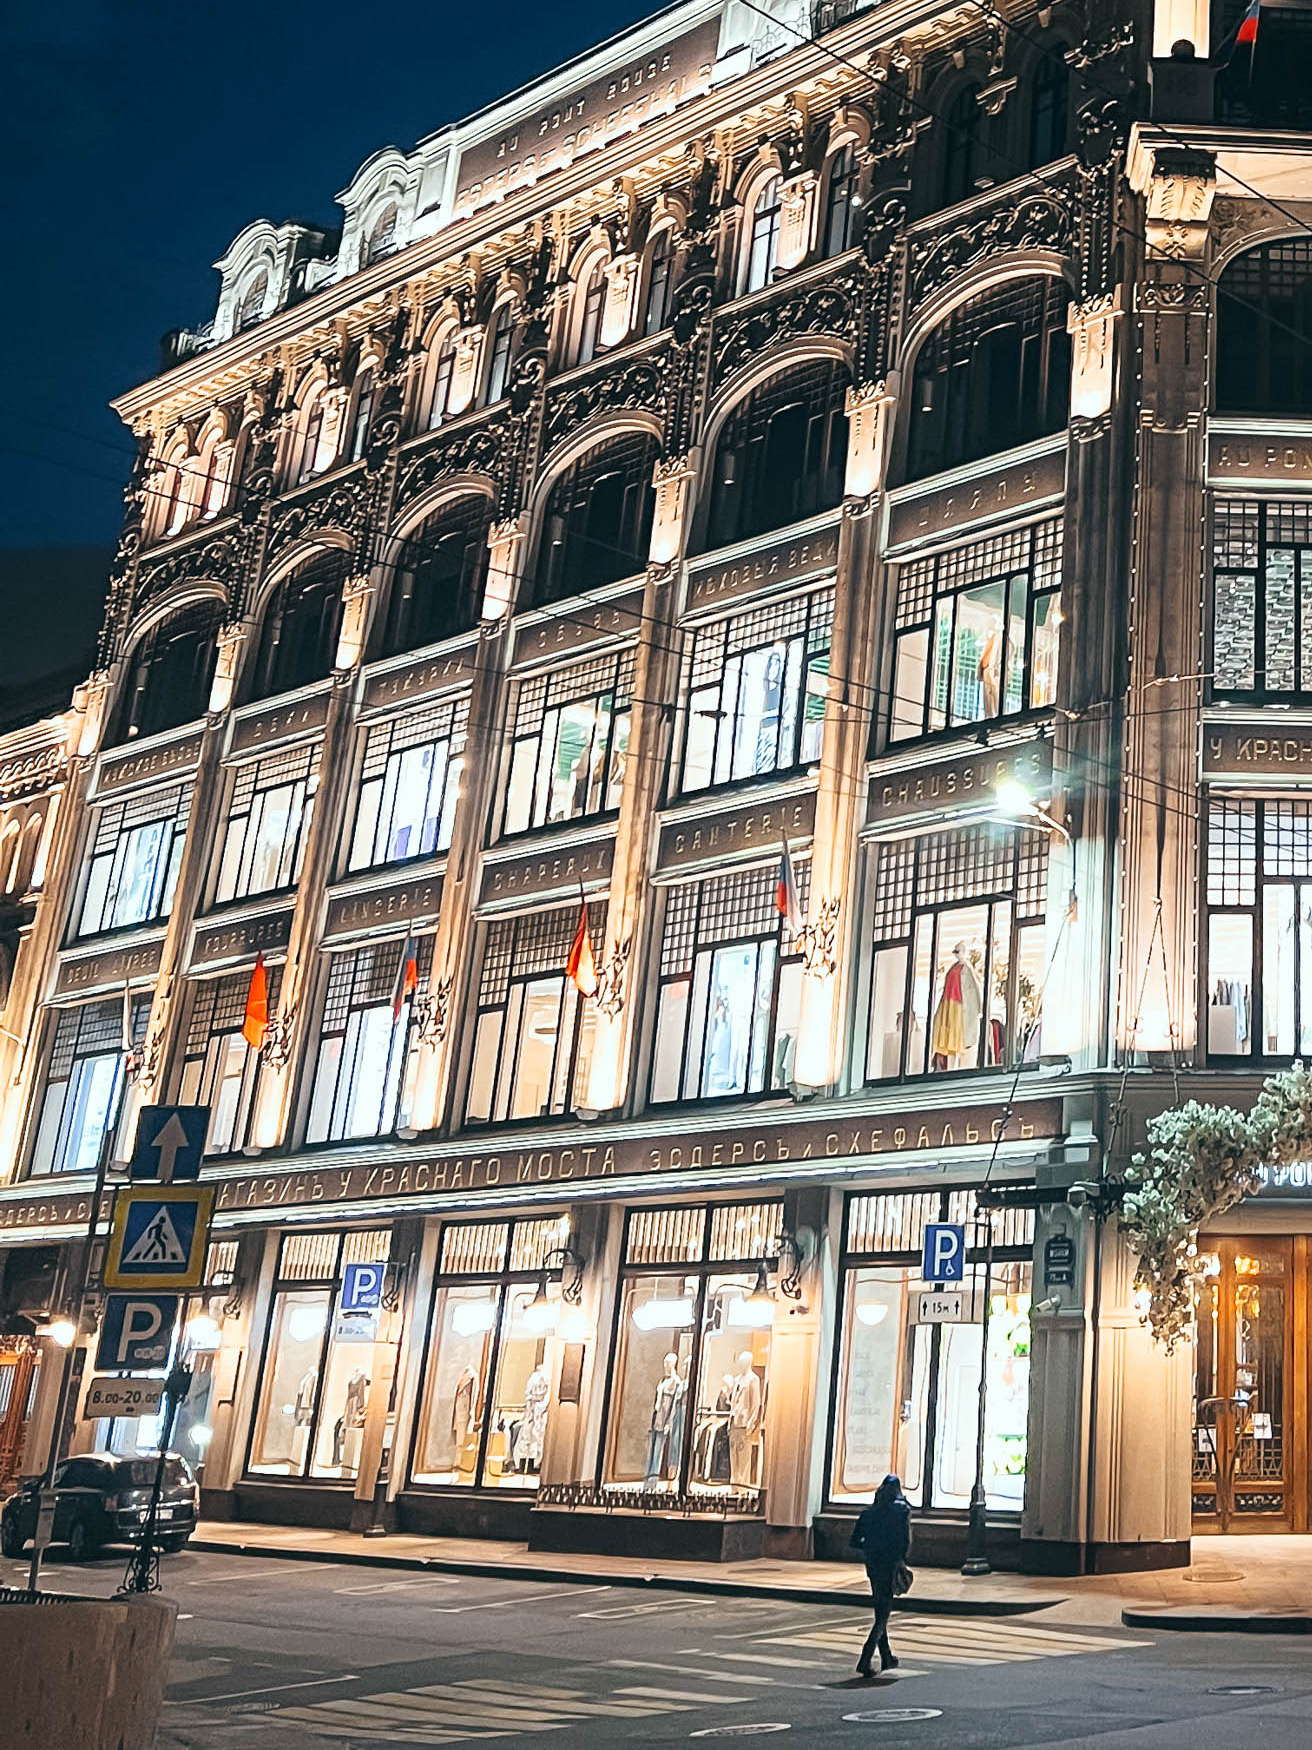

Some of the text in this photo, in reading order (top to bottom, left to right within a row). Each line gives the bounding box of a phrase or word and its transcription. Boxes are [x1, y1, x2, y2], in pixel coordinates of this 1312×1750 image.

[1218, 446, 1250, 467] AU
[1209, 738, 1223, 760] У
[674, 804, 803, 855] GANTERIE
[339, 887, 433, 924] LINGERIE
[339, 1170, 352, 1198] У
[363, 1156, 501, 1196] КРАСНАГО
[516, 1145, 617, 1183] МОСТА
[649, 1138, 790, 1172] ЭСДЕРСЪ
[934, 1229, 959, 1276] P
[116, 1302, 163, 1363] P
